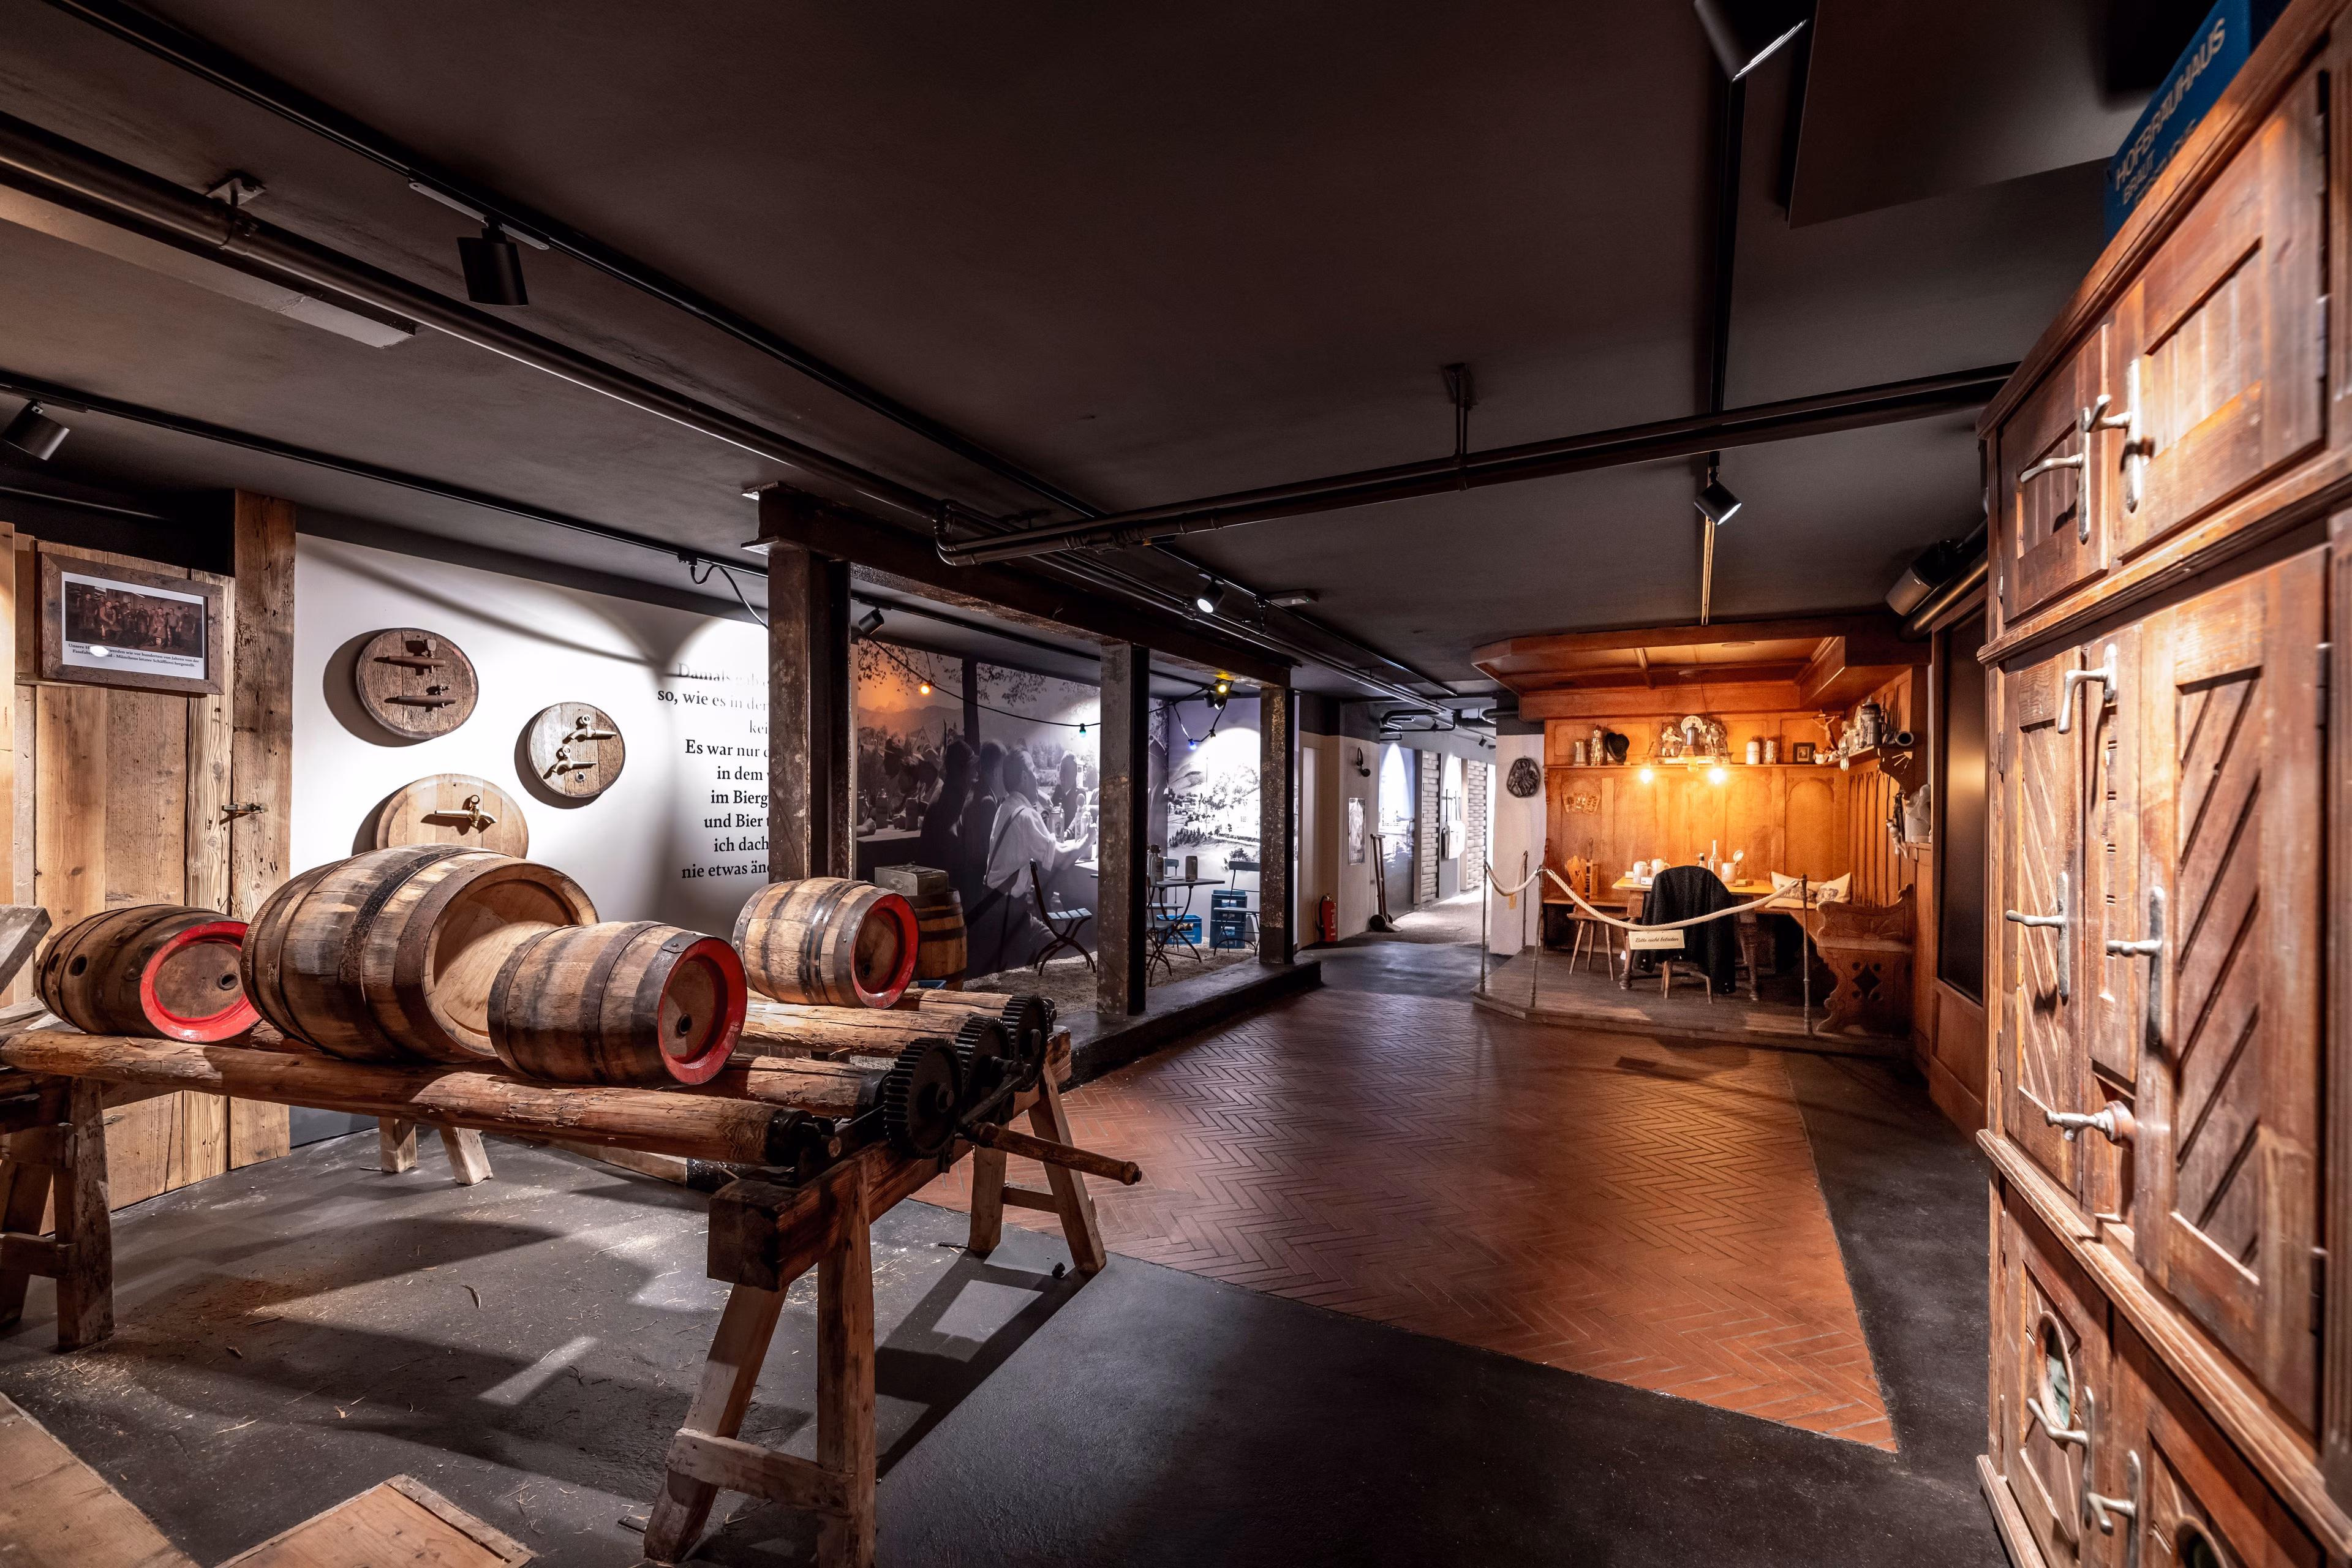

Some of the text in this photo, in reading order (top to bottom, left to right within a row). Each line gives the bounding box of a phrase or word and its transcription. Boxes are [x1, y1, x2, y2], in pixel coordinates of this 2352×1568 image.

[677, 662, 731, 682] Damals
[657, 690, 678, 705] so,
[682, 690, 708, 705] wie
[712, 696, 726, 706] es
[730, 695, 742, 708] in
[685, 739, 703, 754] Es
[706, 745, 733, 756] war
[737, 747, 760, 757] nur
[717, 766, 731, 780] in
[734, 766, 763, 781] dem
[710, 790, 729, 804] im
[704, 813, 732, 828] und
[736, 813, 763, 827] Bier
[714, 836, 735, 852] ich
[681, 863, 704, 878] nie
[708, 864, 748, 877] etwas
